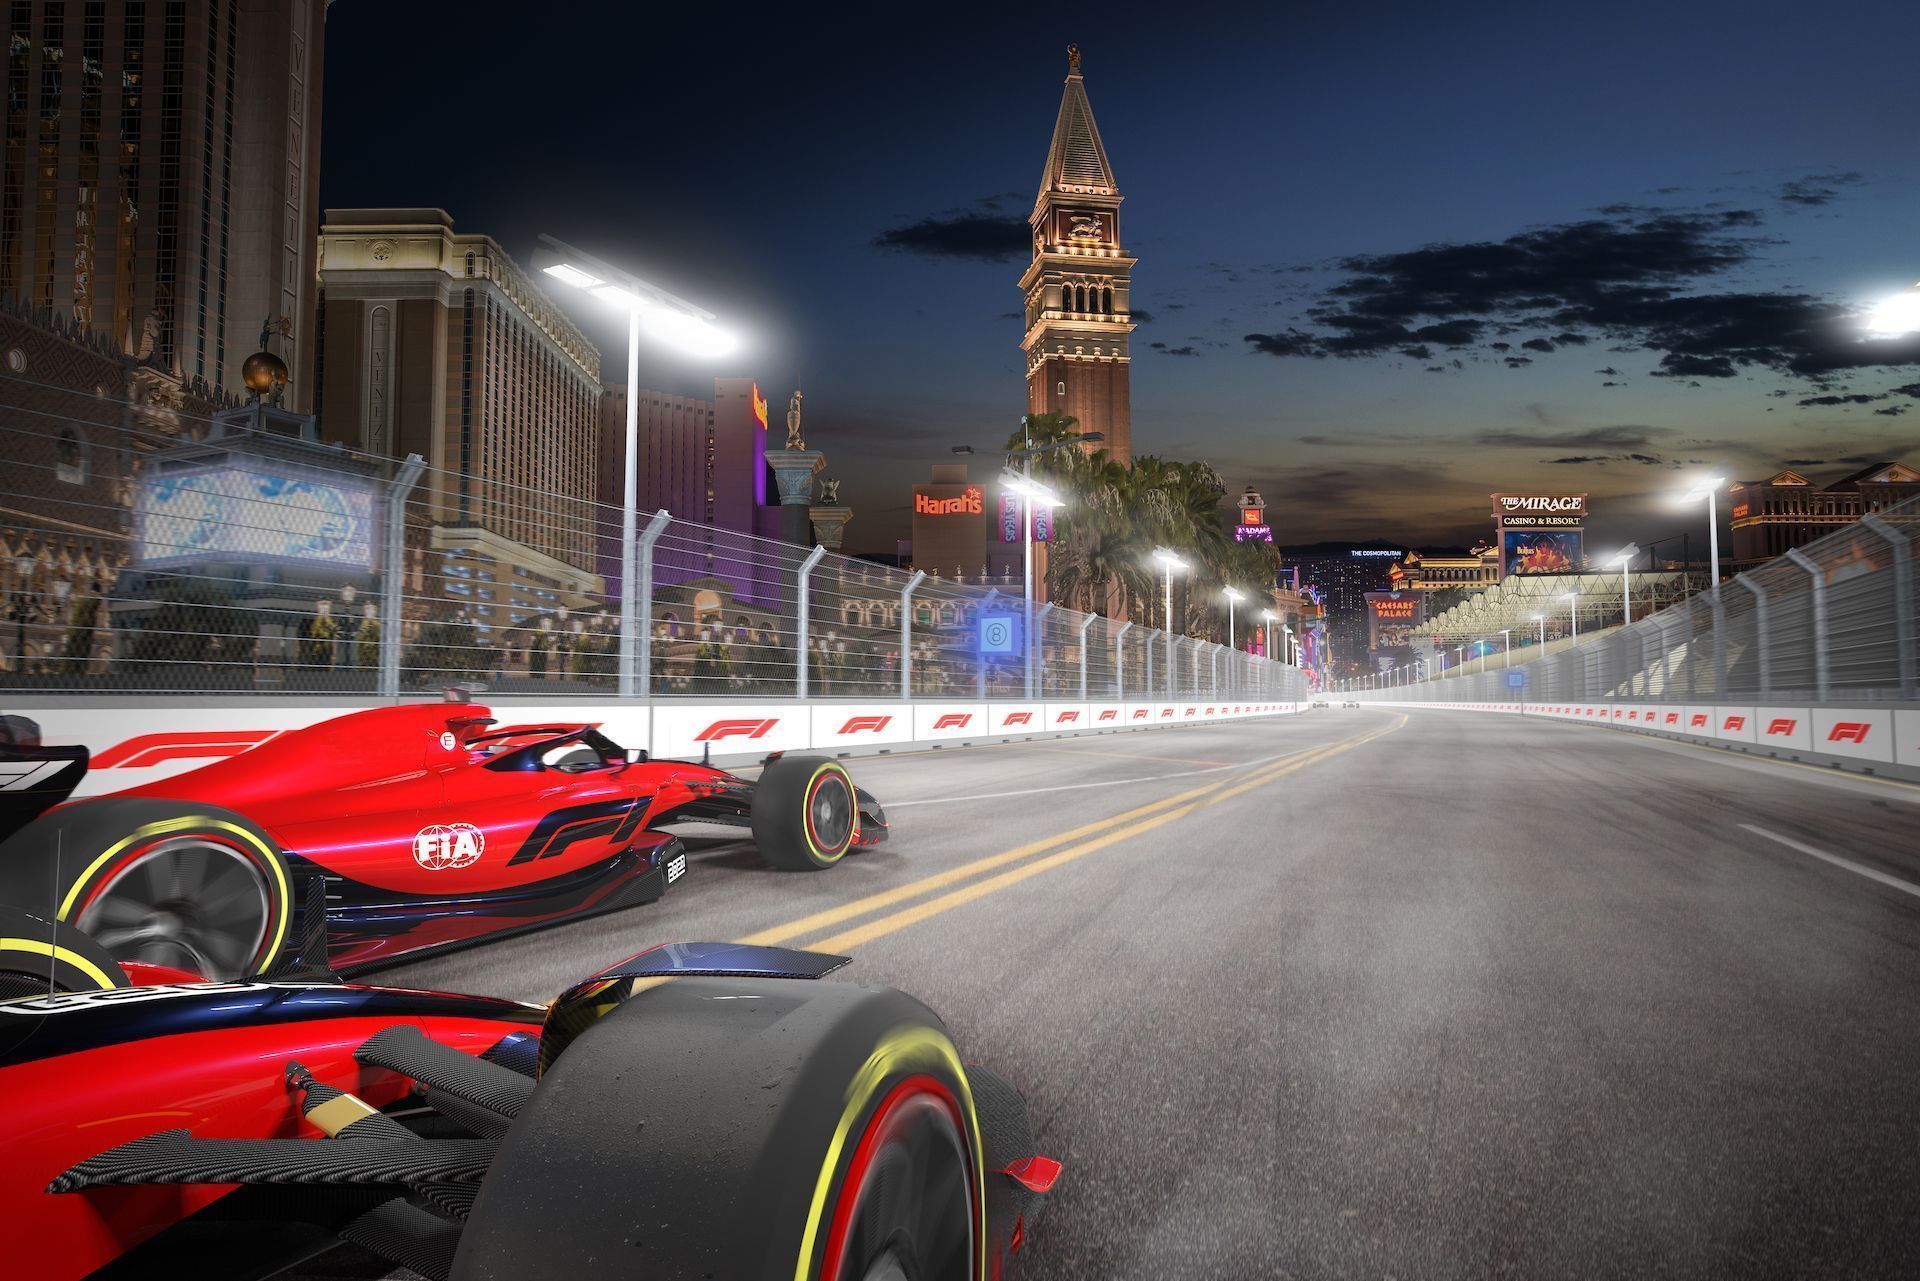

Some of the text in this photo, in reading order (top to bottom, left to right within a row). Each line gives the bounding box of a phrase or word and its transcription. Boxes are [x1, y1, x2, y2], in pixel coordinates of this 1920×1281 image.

[1500, 497, 1582, 511] THE MIRAGE
[1504, 517, 1580, 525] CASINO & RESORT
[1375, 602, 1414, 610] CAESARS
[1378, 610, 1412, 618] PALACE
[837, 716, 893, 735] F1
[932, 714, 973, 729] F1
[1002, 712, 1033, 726] F1
[693, 718, 781, 742] F1
[1767, 718, 1797, 736] F1
[1827, 722, 1873, 744] F1
[506, 795, 654, 867] F1
